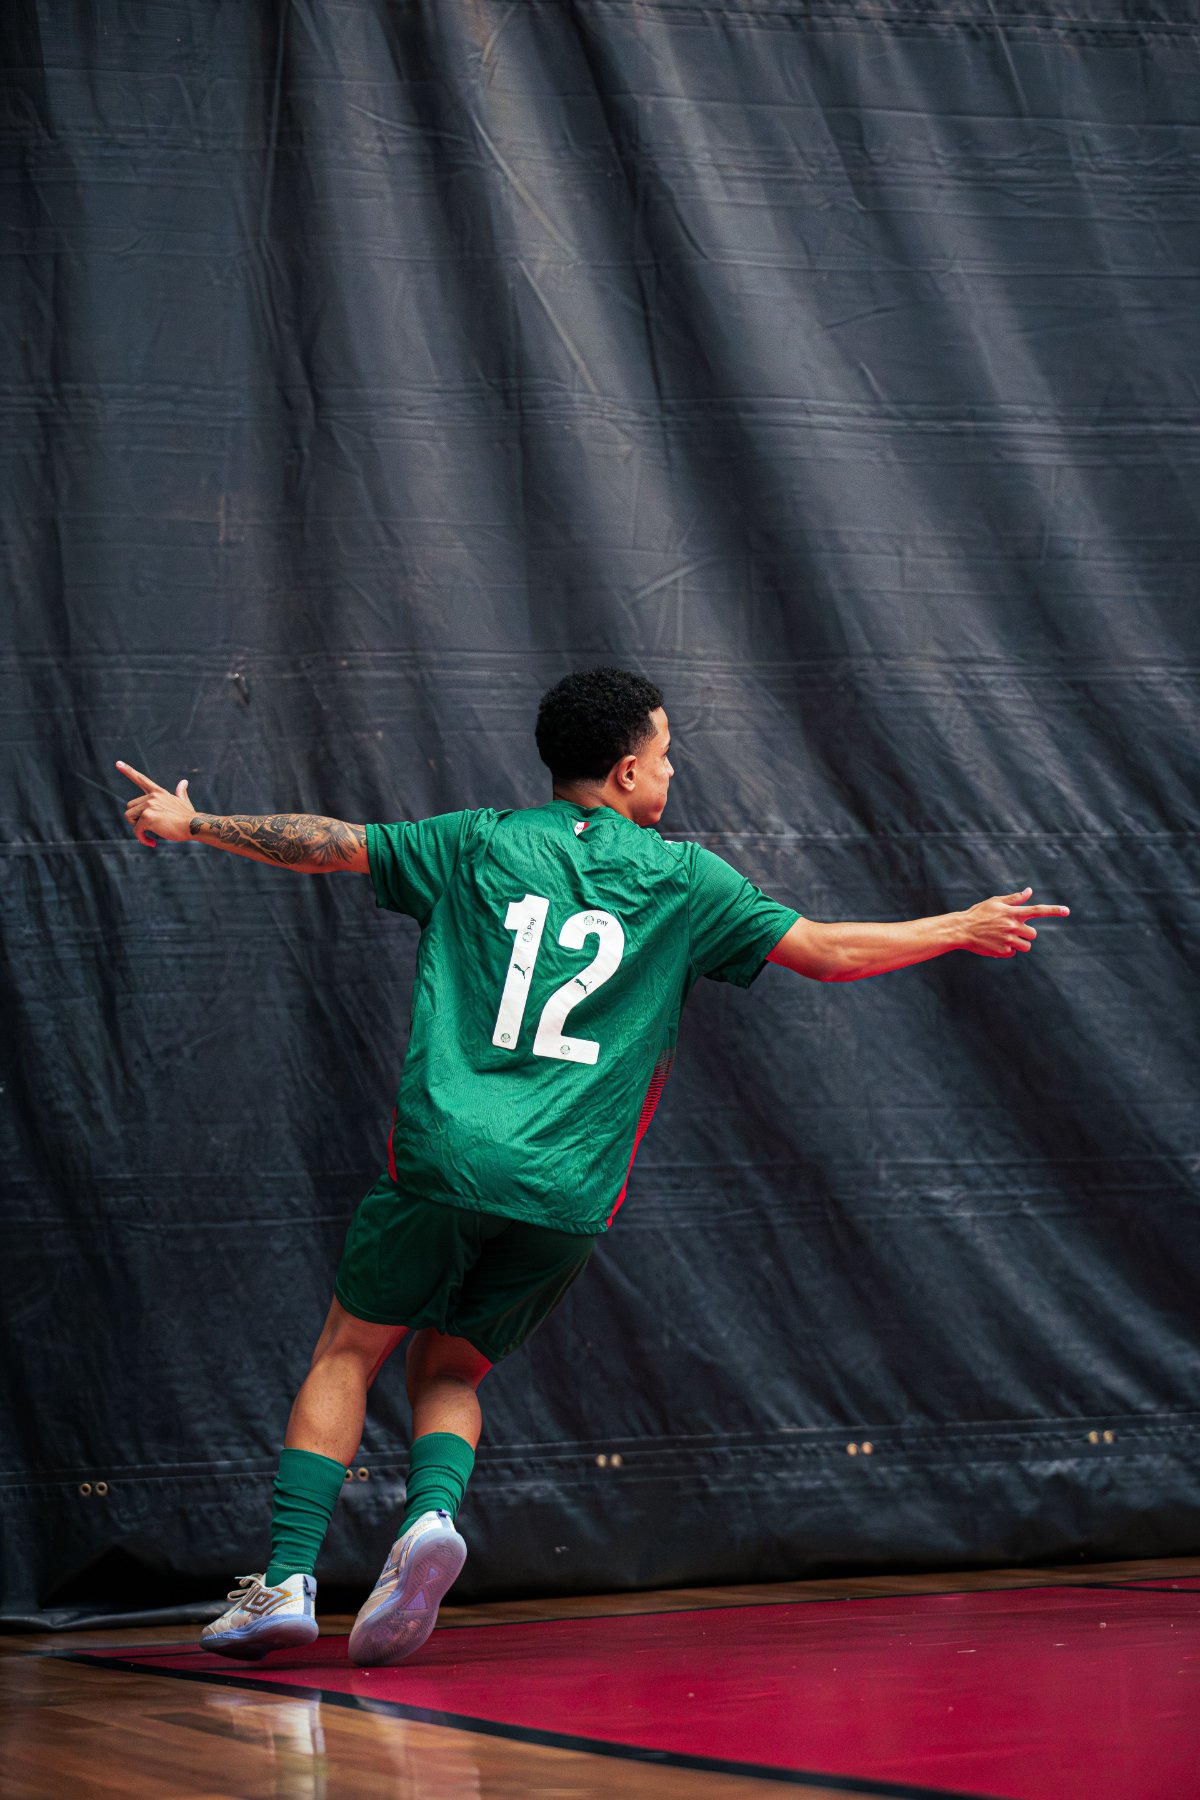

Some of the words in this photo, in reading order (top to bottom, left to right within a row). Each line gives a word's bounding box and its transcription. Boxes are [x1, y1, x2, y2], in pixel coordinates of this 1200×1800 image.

[527, 917, 537, 930] Pay
[596, 918, 609, 927] Pay
[492, 894, 625, 1065] 12
